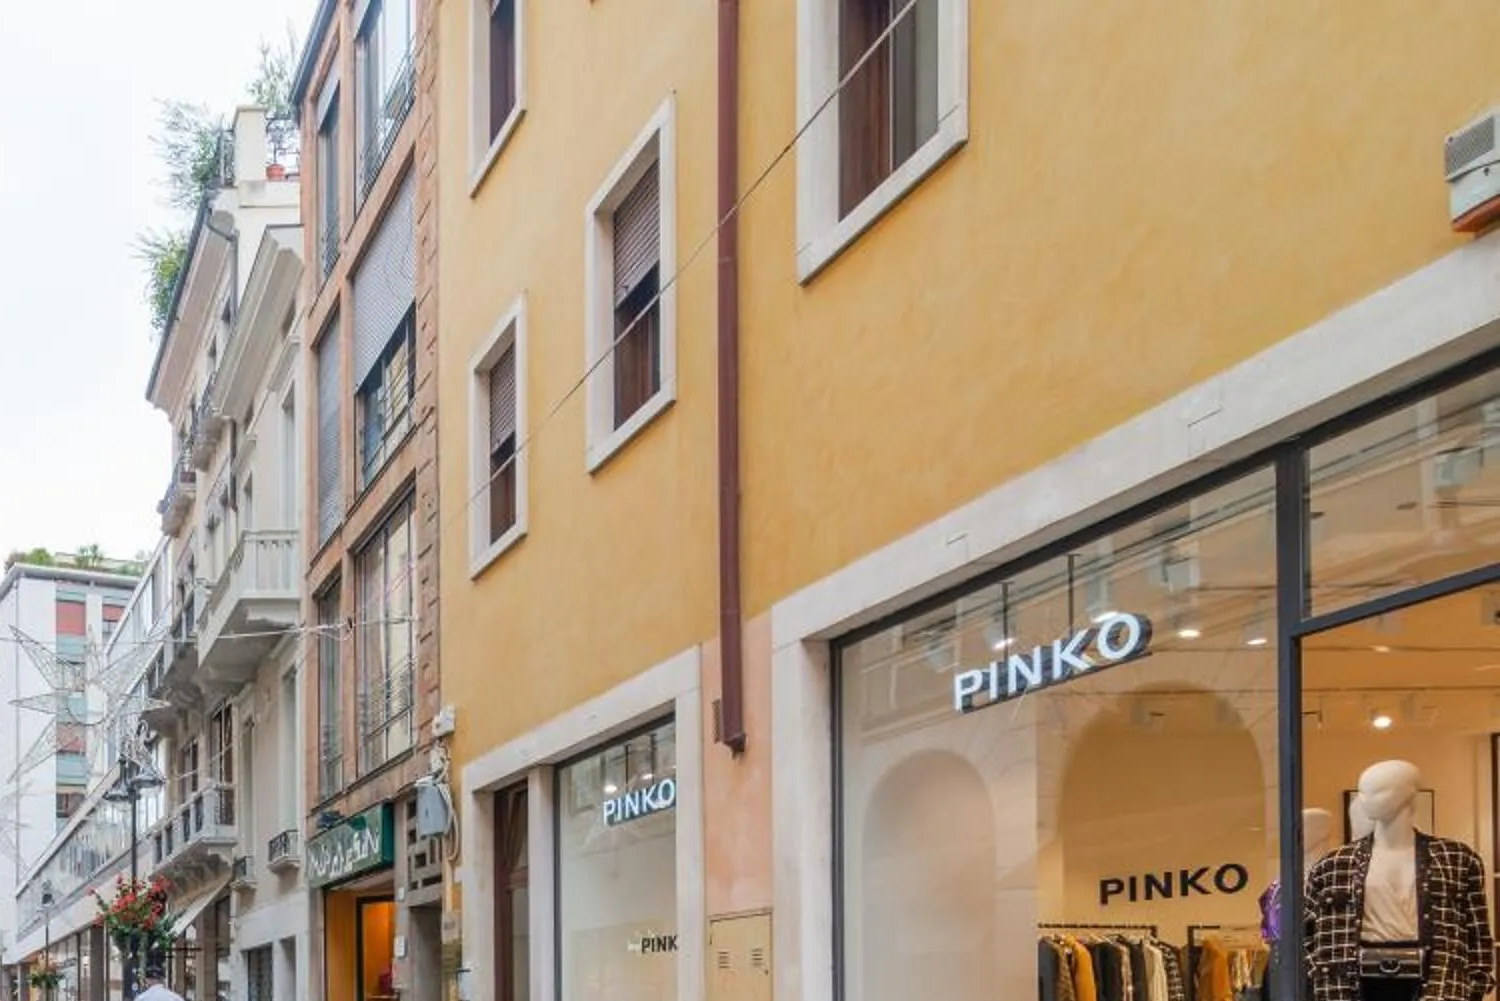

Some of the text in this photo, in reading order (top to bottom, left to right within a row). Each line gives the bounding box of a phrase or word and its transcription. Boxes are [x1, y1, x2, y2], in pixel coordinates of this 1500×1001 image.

[953, 612, 1145, 713] PINKO
[603, 777, 675, 827] PINKO
[1099, 862, 1249, 905] PINKO
[641, 934, 678, 955] PINK
